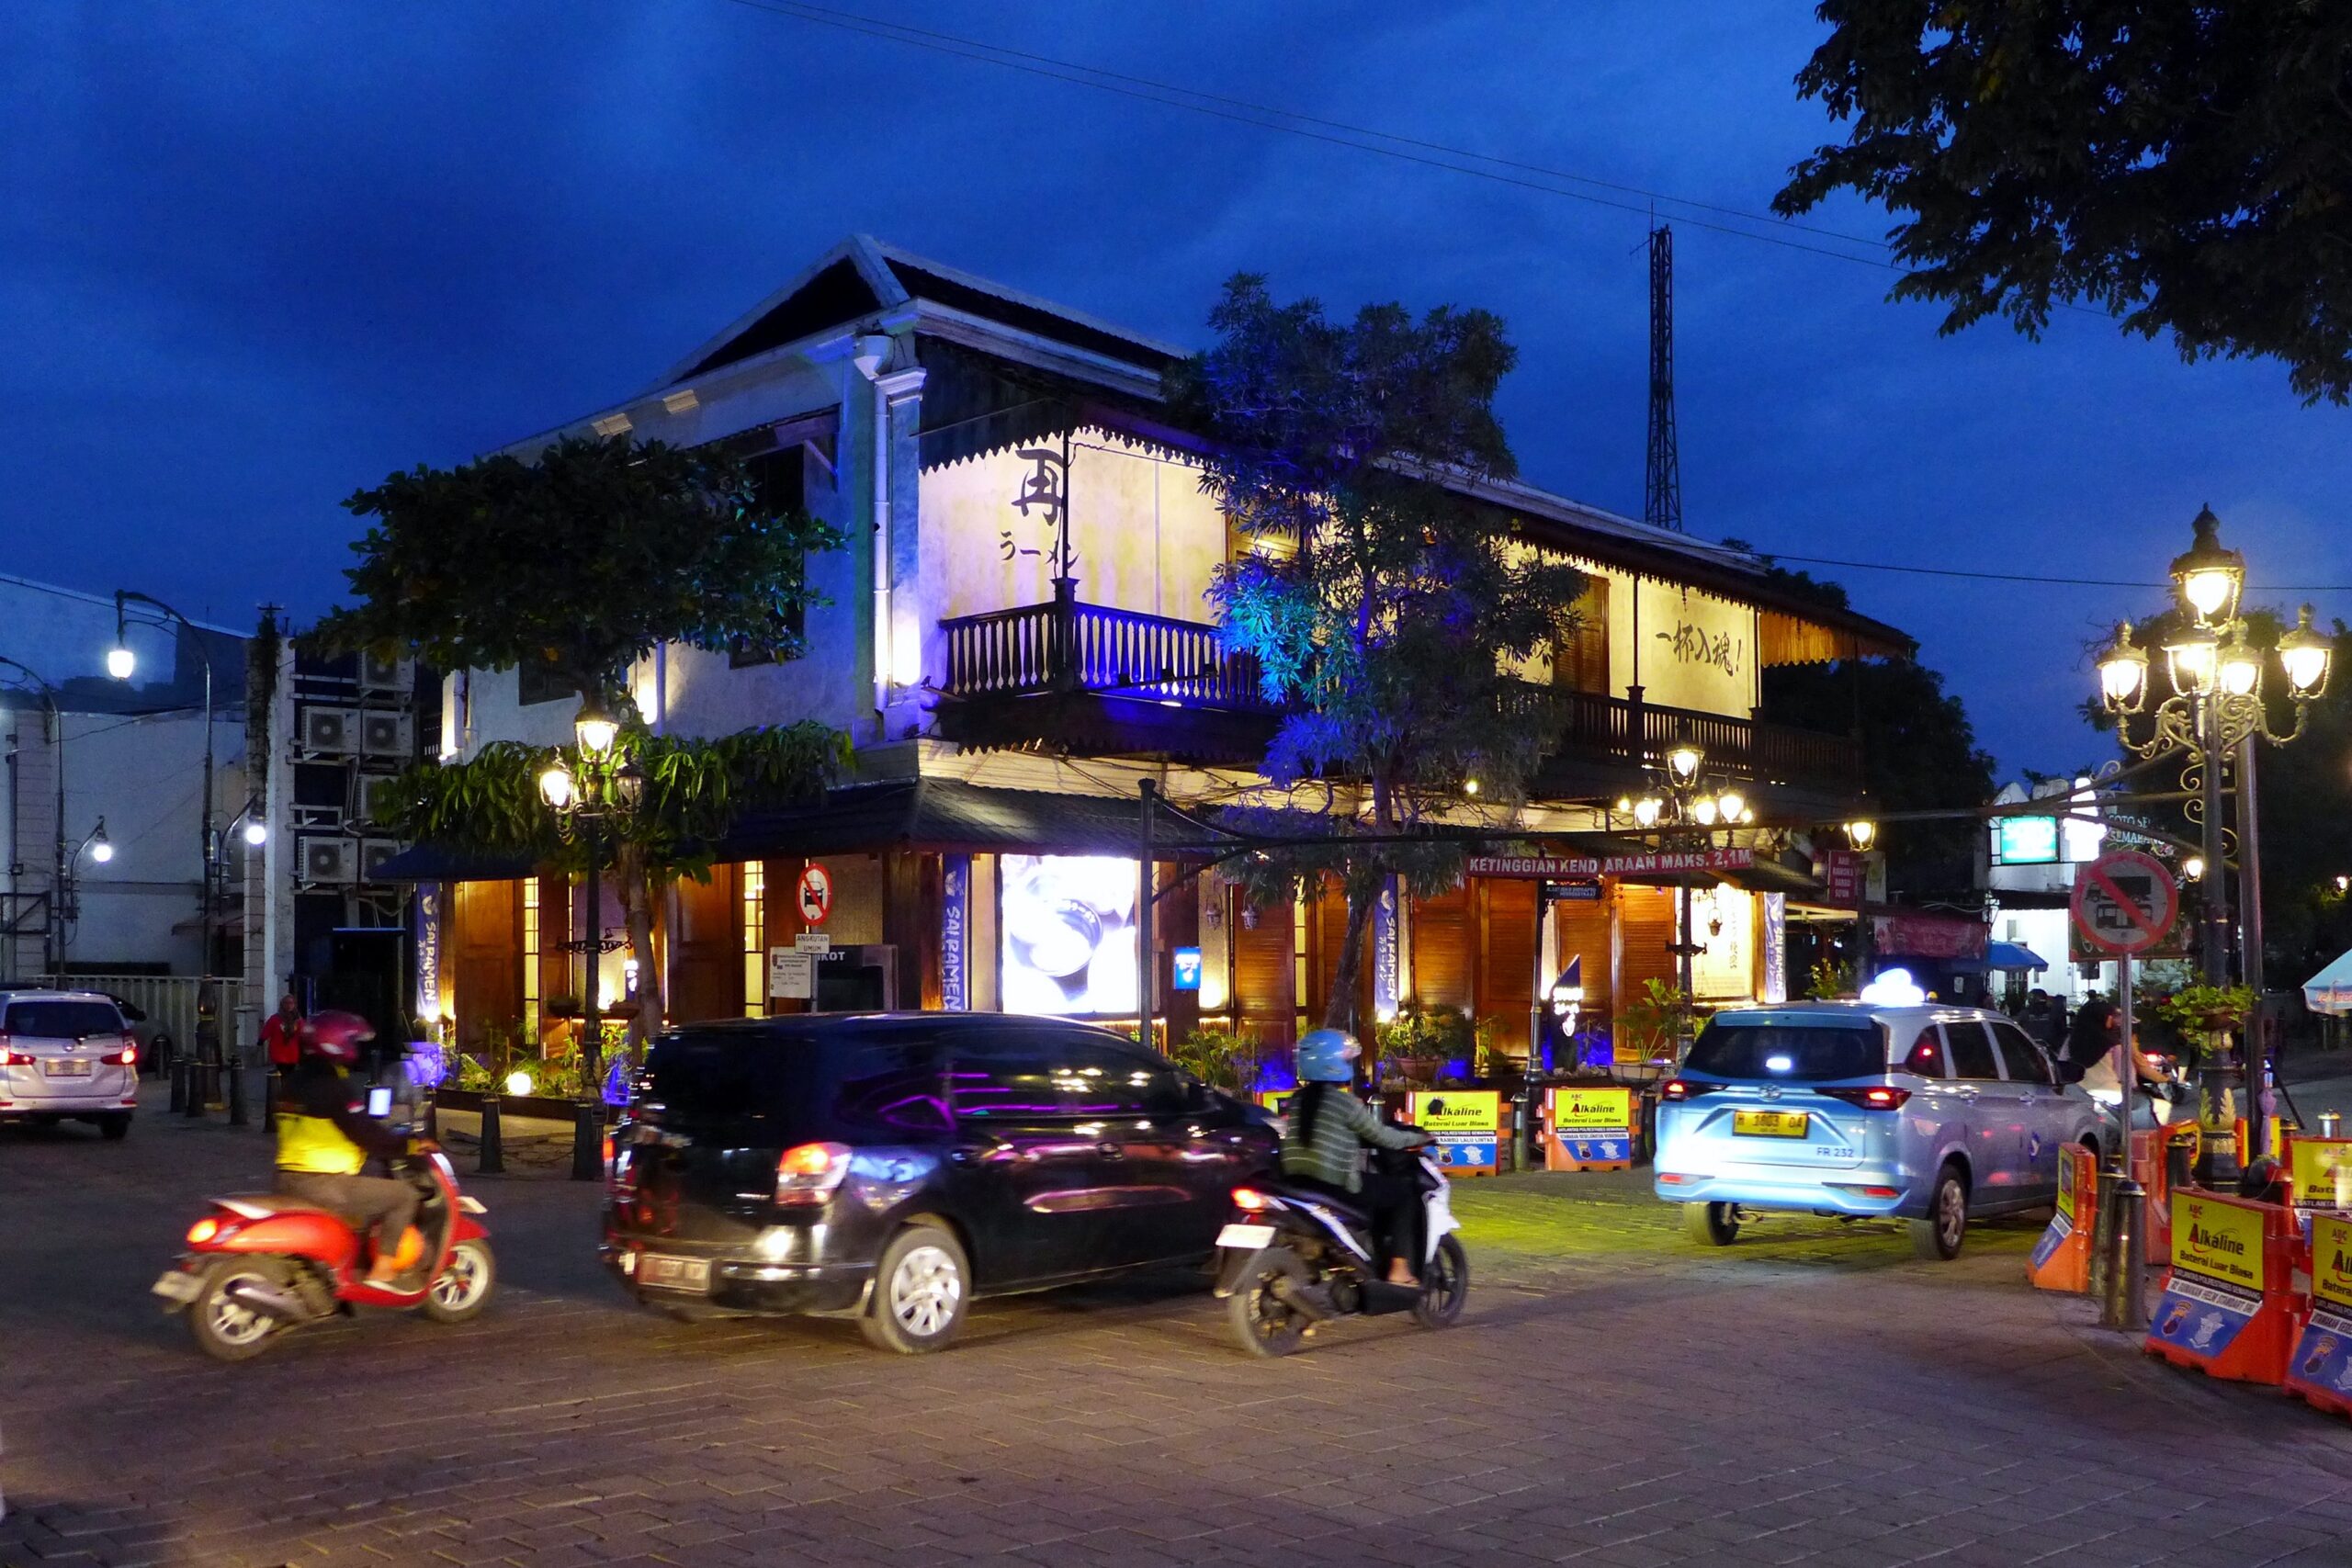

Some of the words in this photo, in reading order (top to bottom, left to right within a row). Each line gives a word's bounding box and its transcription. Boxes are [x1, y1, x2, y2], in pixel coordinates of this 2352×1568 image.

[1470, 857, 1555, 873] KETINGGIAN
[1661, 853, 1710, 869] MAKS.
[1713, 849, 1751, 868] 2,1M
[1434, 1105, 1482, 1116] lkaline
[1571, 1102, 1615, 1113] Alkaline
[1817, 1147, 1831, 1156] FR
[1834, 1148, 1854, 1157] 232
[2188, 1203, 2203, 1215] ABC
[2188, 1223, 2245, 1256] Alkaline
[2210, 1258, 2229, 1272] Luar
[2230, 1263, 2254, 1280] Biasa
